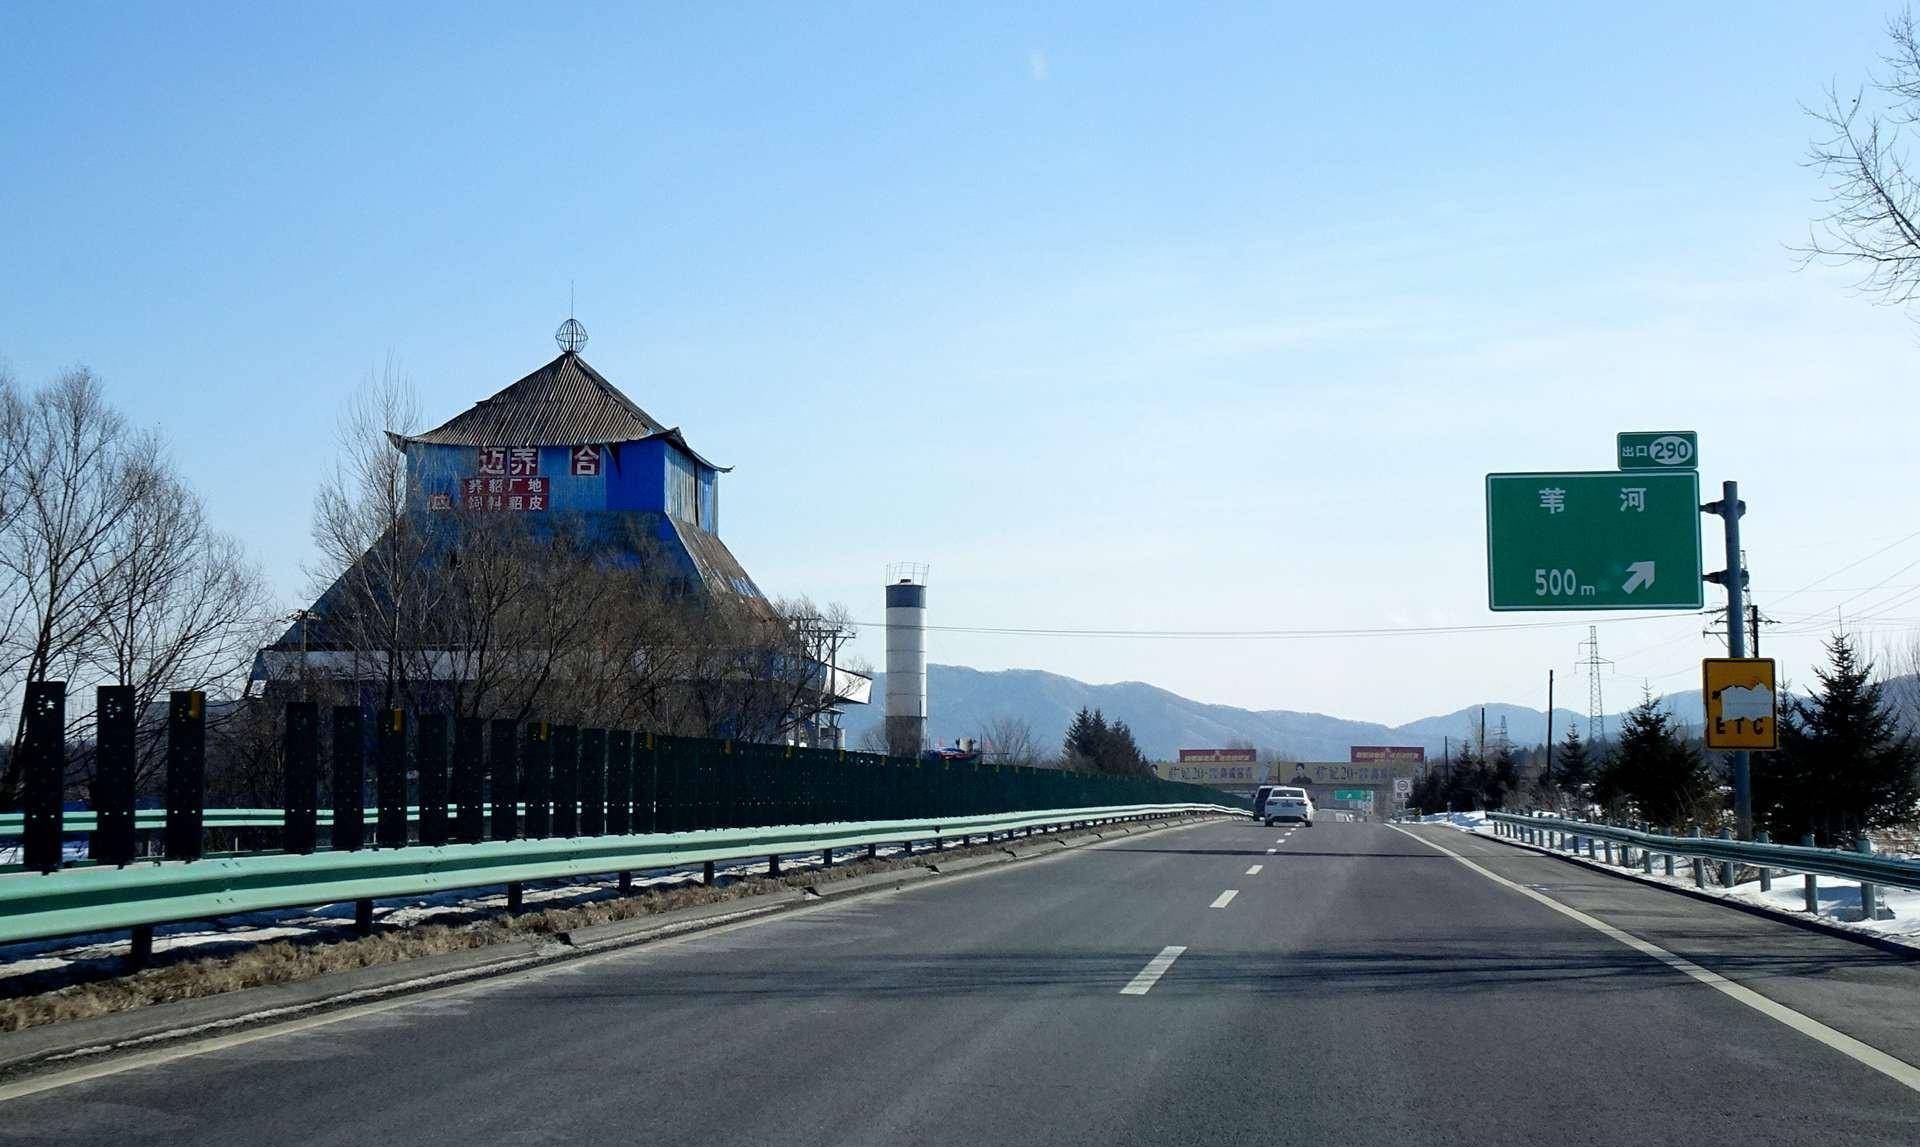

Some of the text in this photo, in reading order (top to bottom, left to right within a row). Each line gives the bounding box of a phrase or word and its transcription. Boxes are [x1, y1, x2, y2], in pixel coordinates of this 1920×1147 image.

[1621, 442, 1690, 460] 出口 290
[1538, 487, 1648, 514] 苇河
[1535, 568, 1597, 597] 500 m
[1715, 716, 1764, 736] ETC
